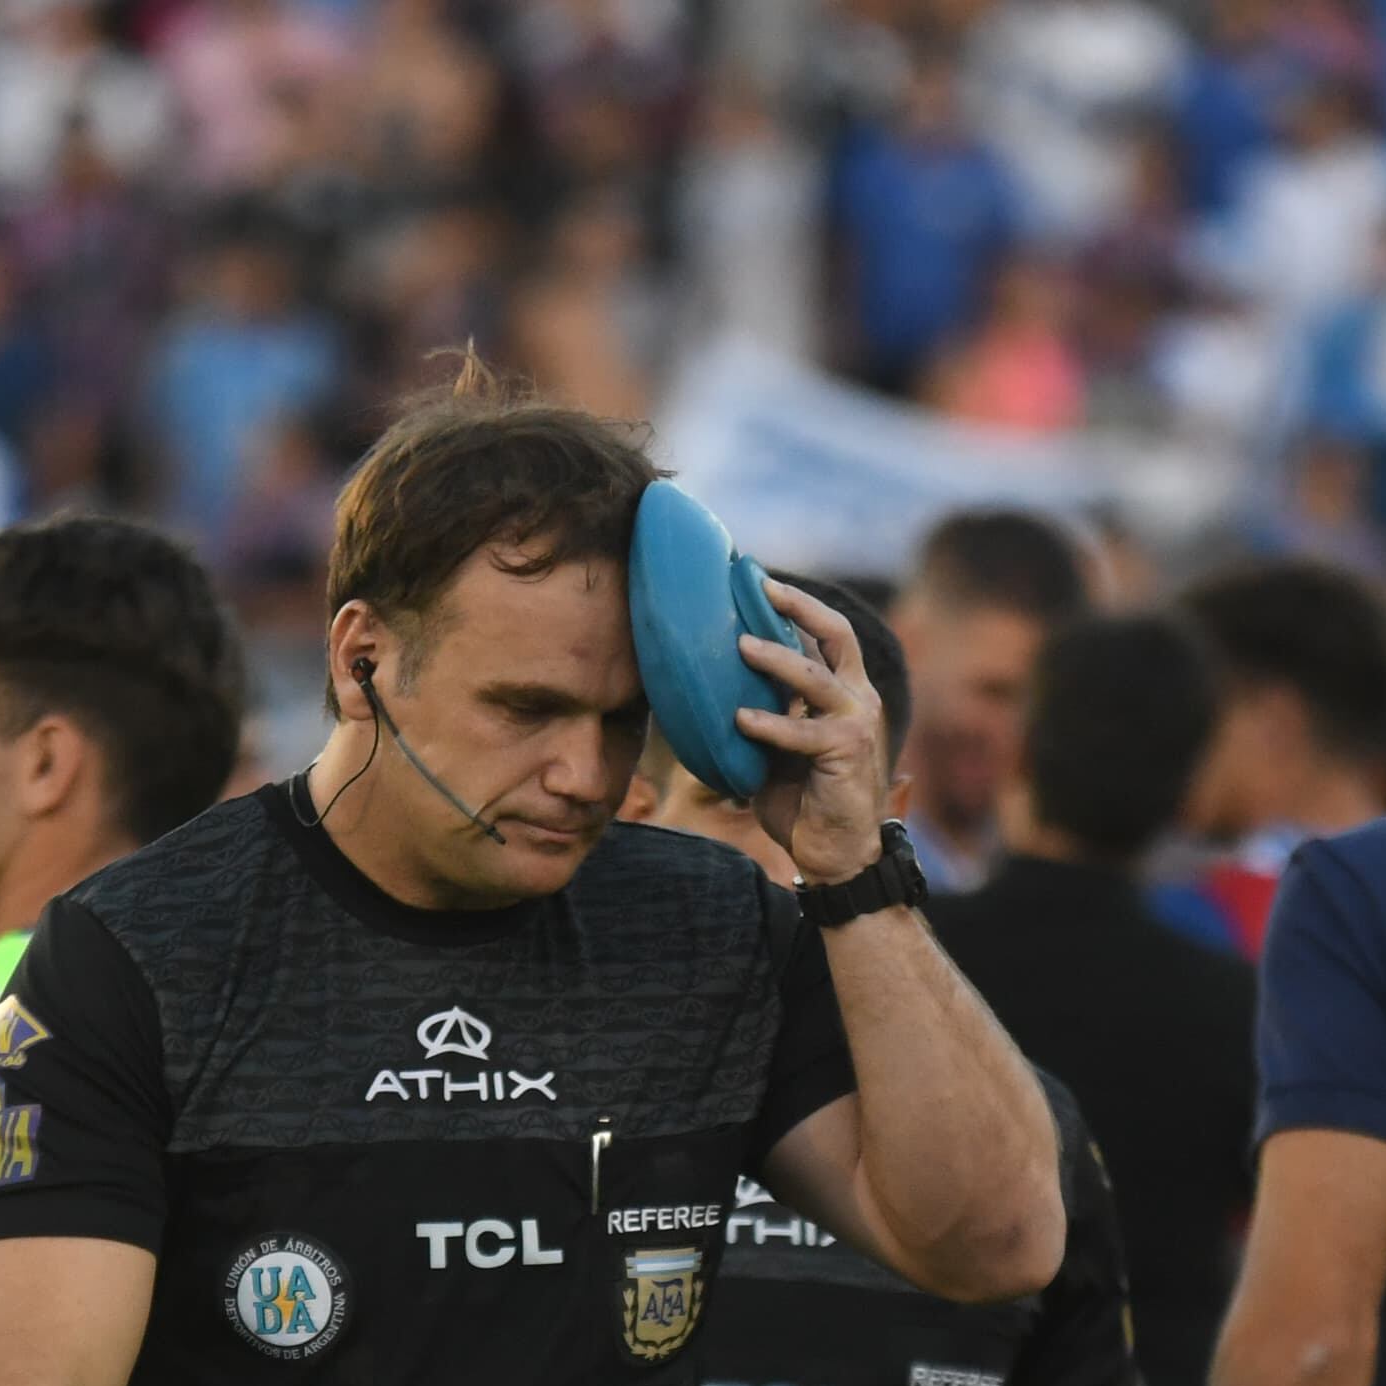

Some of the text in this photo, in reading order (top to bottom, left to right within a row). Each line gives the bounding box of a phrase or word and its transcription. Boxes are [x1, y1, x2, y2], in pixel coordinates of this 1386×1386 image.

[365, 1069, 558, 1101] ATHIX
[607, 1204, 722, 1235] REFEREE
[726, 1216, 837, 1248] THI
[225, 1237, 342, 1289] UNIÓN DE ÁRBITROS
[416, 1219, 564, 1270] TCL
[283, 1349, 301, 1360] DE
[303, 1292, 346, 1357] ARGENTINA
